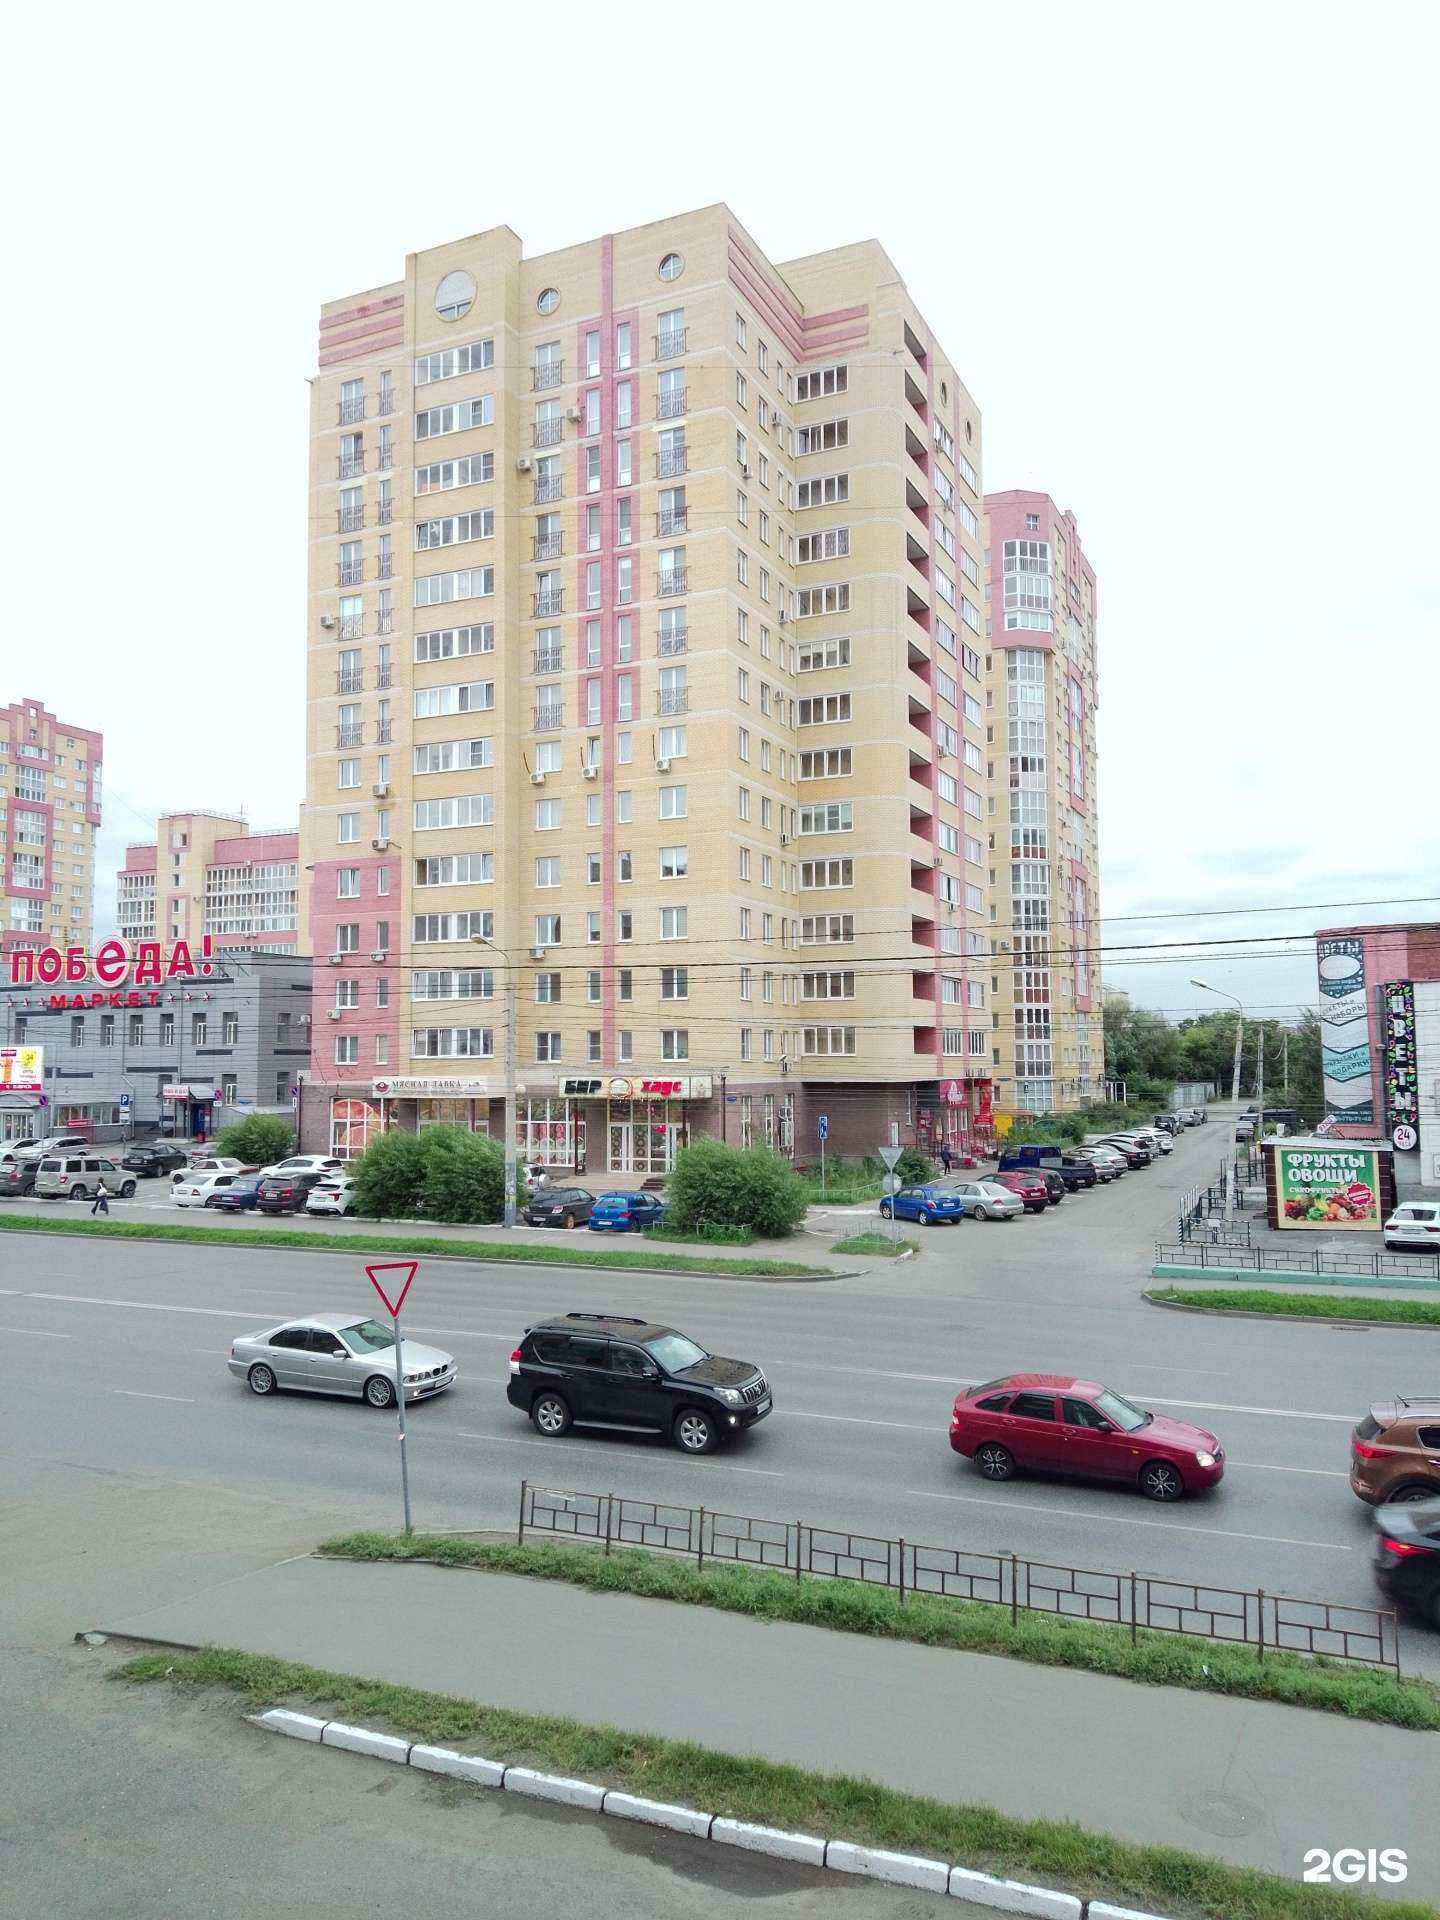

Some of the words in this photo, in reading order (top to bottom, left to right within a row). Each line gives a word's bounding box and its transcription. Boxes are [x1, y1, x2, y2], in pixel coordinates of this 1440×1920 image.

[50, 991, 161, 1008] МАРКЕТ
[1397, 1128, 1410, 1140] 24
[1287, 1153, 1366, 1168] ФРУКТЫ
[1288, 1168, 1358, 1185] ОВОЩИ
